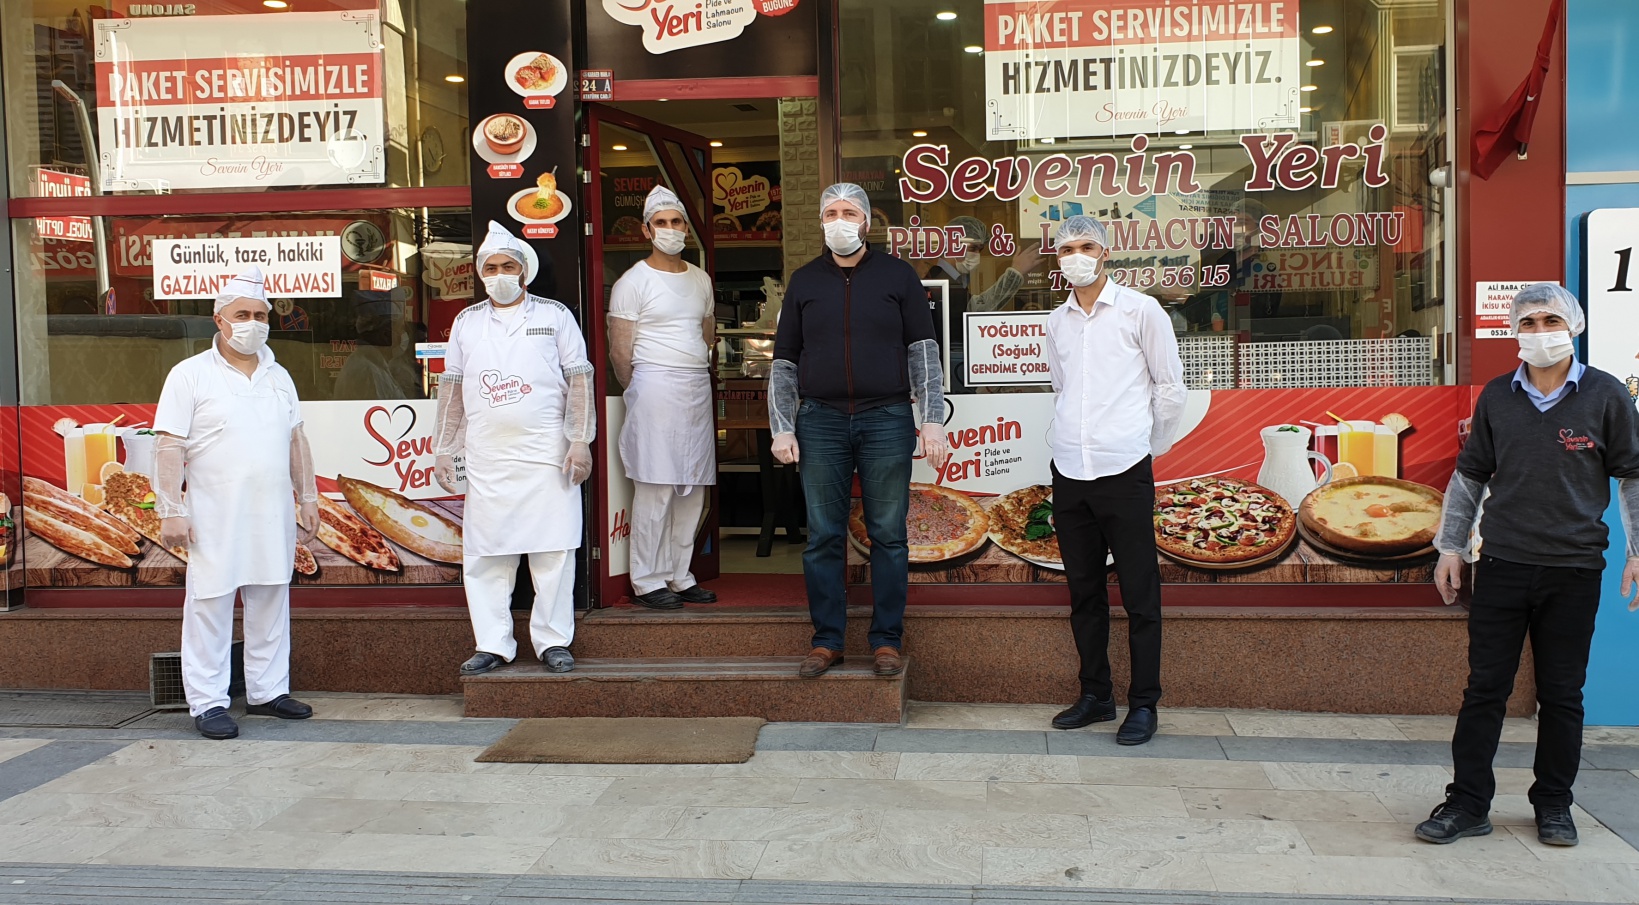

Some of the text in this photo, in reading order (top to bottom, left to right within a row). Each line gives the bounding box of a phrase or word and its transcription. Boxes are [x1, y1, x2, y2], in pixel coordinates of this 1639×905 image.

[651, 4, 703, 41] Yeri
[706, 19, 732, 29] Salonu
[998, 0, 1284, 45] PAKET SERVİSİMİZLE
[108, 58, 369, 102] PAKET SERVİSİMİZLE
[1002, 43, 1282, 95] HİZMETİNİZDEYİZ.
[582, 80, 597, 92] 24
[604, 79, 612, 92] A
[1095, 100, 1188, 126] Sevenin Yeri
[113, 103, 368, 149] HİZMETİNİZDEYİZ.
[200, 155, 284, 181] Sevenin Yeri
[899, 124, 1389, 203] Sevenin Yeri
[714, 172, 765, 200] Sevenin
[614, 194, 646, 209] GÜMÜŞH
[728, 197, 749, 213] Yeri
[887, 212, 1405, 259] PİDE & LMACUN SALONU
[170, 243, 229, 267] Günlük,
[235, 245, 272, 266] taze,
[277, 242, 323, 263] hakiki
[161, 269, 335, 295] GAZİANT AKLAVASI
[1113, 264, 1231, 289] 213 56 15
[1607, 247, 1633, 292] 1
[444, 277, 468, 295] Yeri
[1488, 283, 1499, 291] ALİ
[977, 321, 1046, 338] YOĞURTL
[992, 343, 1041, 359] (Soğuk)
[971, 361, 1050, 375] GENDİME ÇORB
[482, 374, 520, 395] Sevenin
[717, 390, 756, 400] AZİANTEP
[491, 391, 507, 404] Yeri
[984, 447, 1001, 458] Pide
[394, 459, 435, 492] Yer
[935, 451, 982, 486] Yeri
[985, 467, 1010, 477] Salonu
